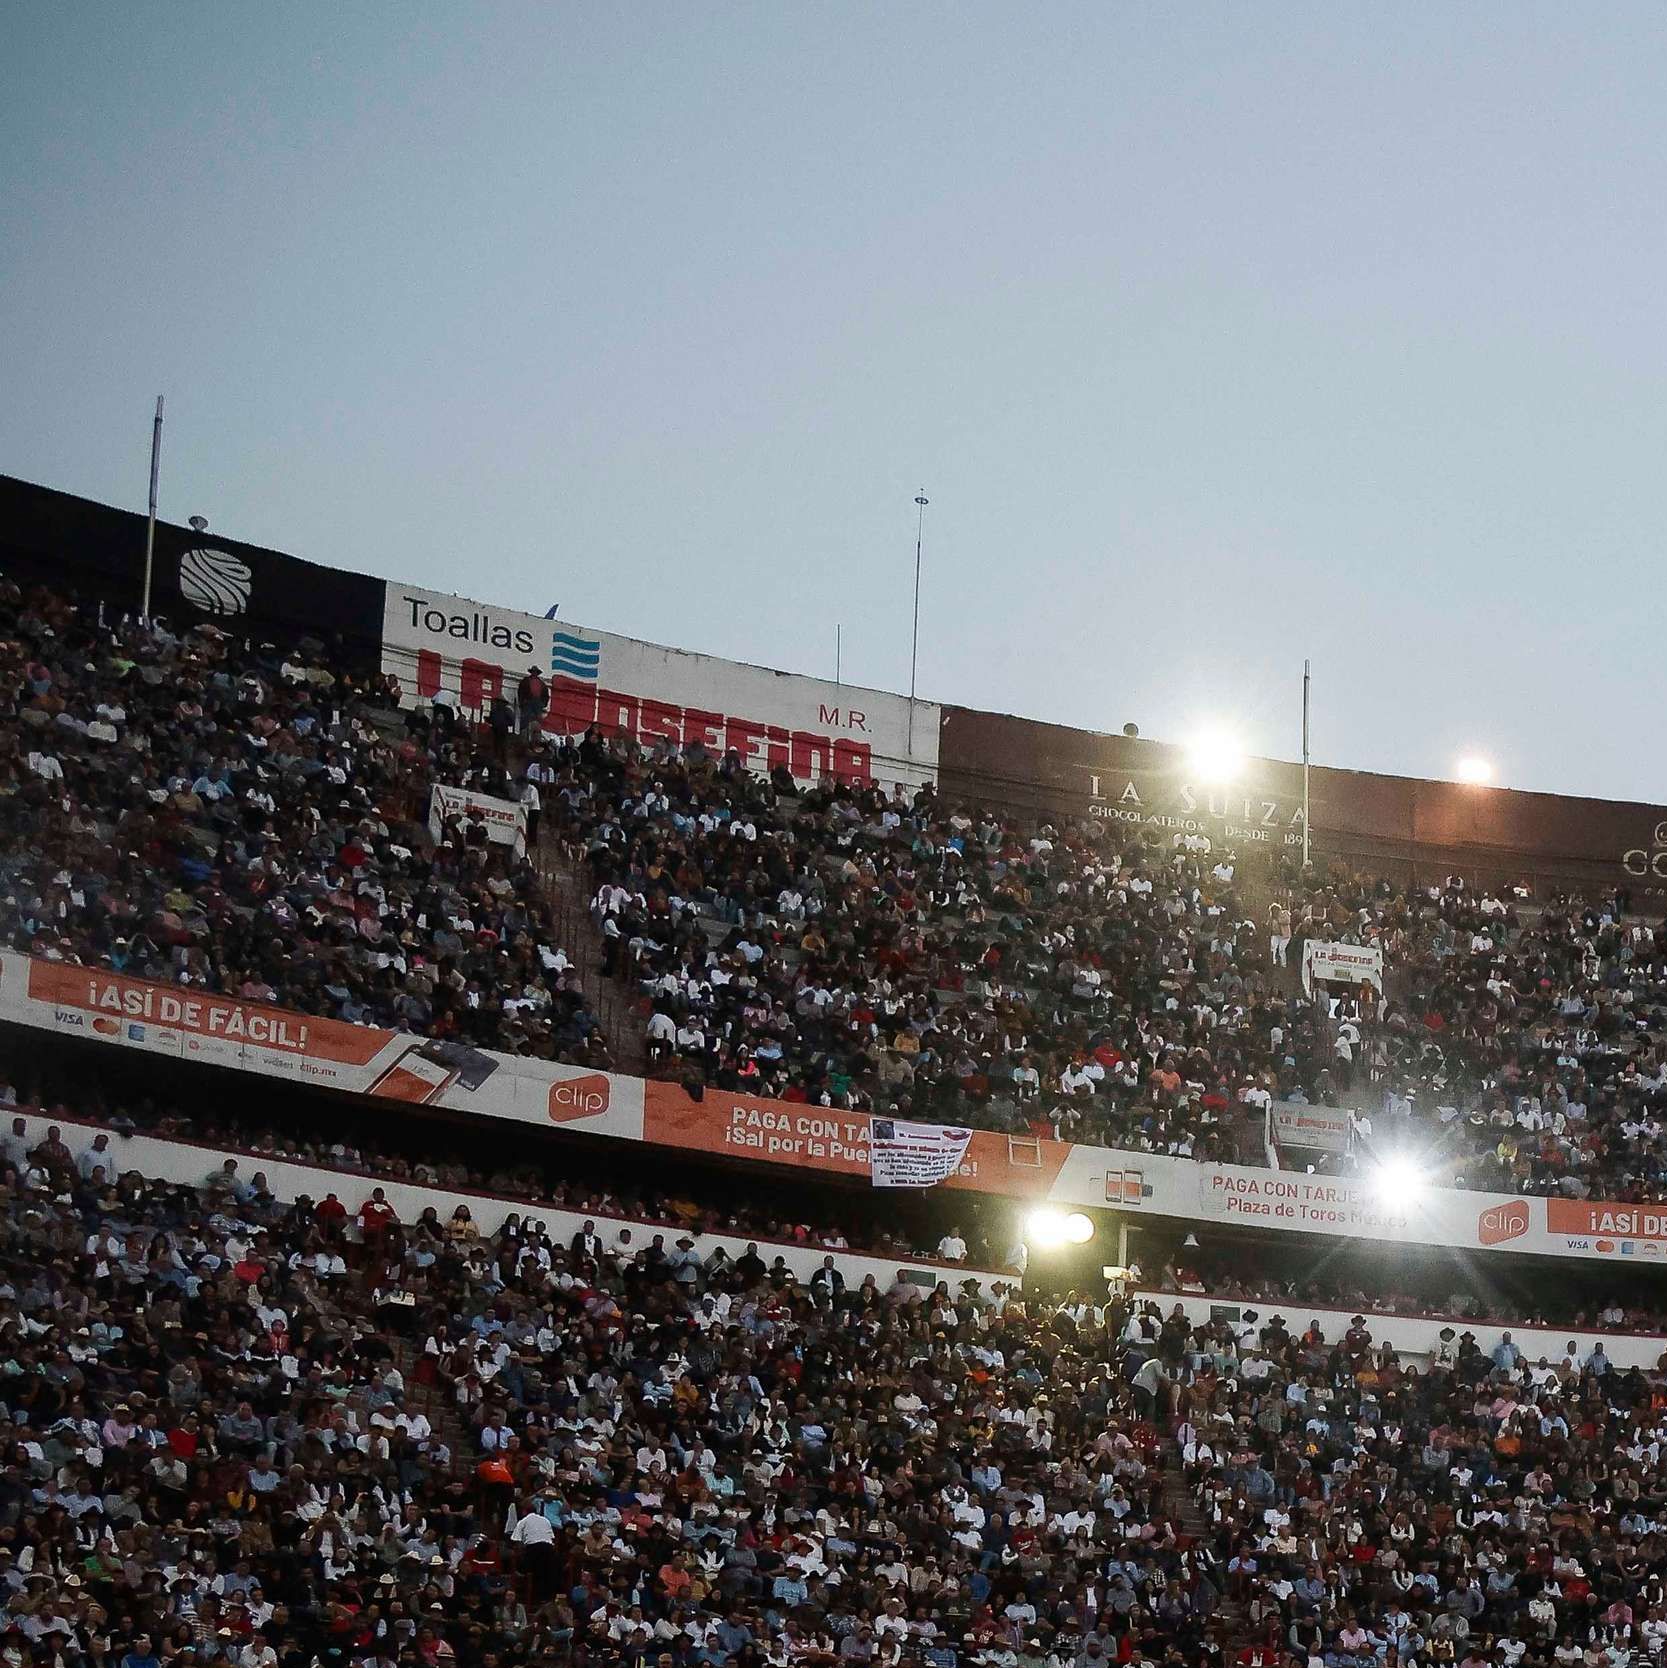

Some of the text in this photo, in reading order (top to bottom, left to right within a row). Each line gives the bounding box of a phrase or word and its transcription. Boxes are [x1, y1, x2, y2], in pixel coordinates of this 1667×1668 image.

[402, 595, 535, 655] Toallas
[818, 703, 873, 733] M.R.
[1088, 775, 1314, 832] LA SUIZA
[1284, 833, 1312, 846] 189
[54, 1010, 84, 1027] VISA
[89, 980, 309, 1049] ¡ASÍ DE FÁCIL!
[555, 1086, 604, 1113] clip
[731, 1106, 791, 1133] PAGA
[795, 1116, 840, 1138] CON
[768, 1134, 803, 1155] por
[807, 1137, 825, 1158] la
[1212, 1175, 1259, 1197] PAGA
[1263, 1180, 1299, 1198] CON
[1226, 1197, 1271, 1217] Plaza
[1274, 1202, 1296, 1218] de
[1299, 1203, 1346, 1224] Toros
[1482, 1211, 1524, 1235] clip
[1590, 1210, 1639, 1234] ¡ASÍ
[1566, 1239, 1589, 1250] VISA
